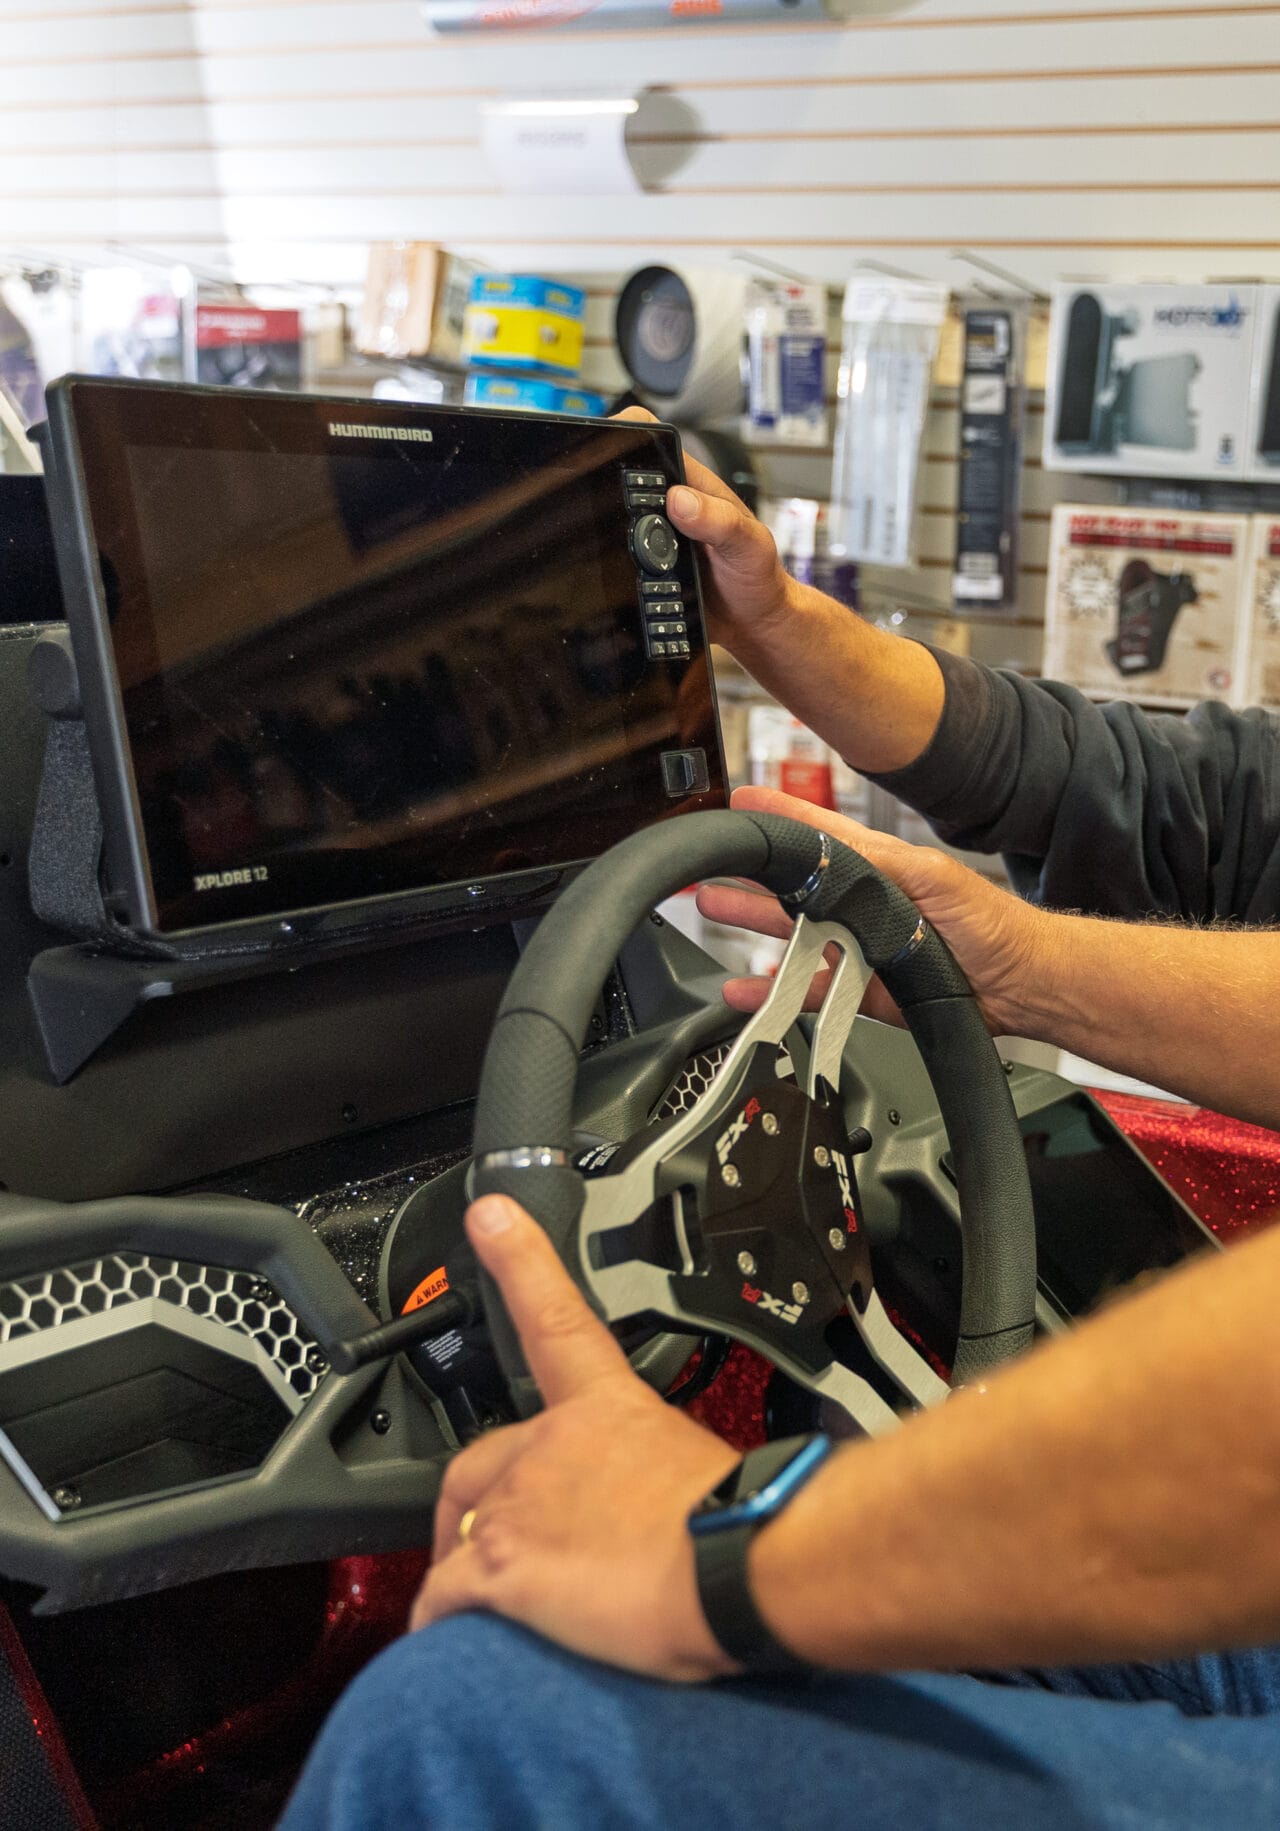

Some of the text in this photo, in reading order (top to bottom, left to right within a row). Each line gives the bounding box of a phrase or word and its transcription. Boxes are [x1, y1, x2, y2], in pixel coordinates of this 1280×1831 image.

[328, 422, 433, 442] HUMMINBIRD
[195, 866, 268, 891] XPLORE 12
